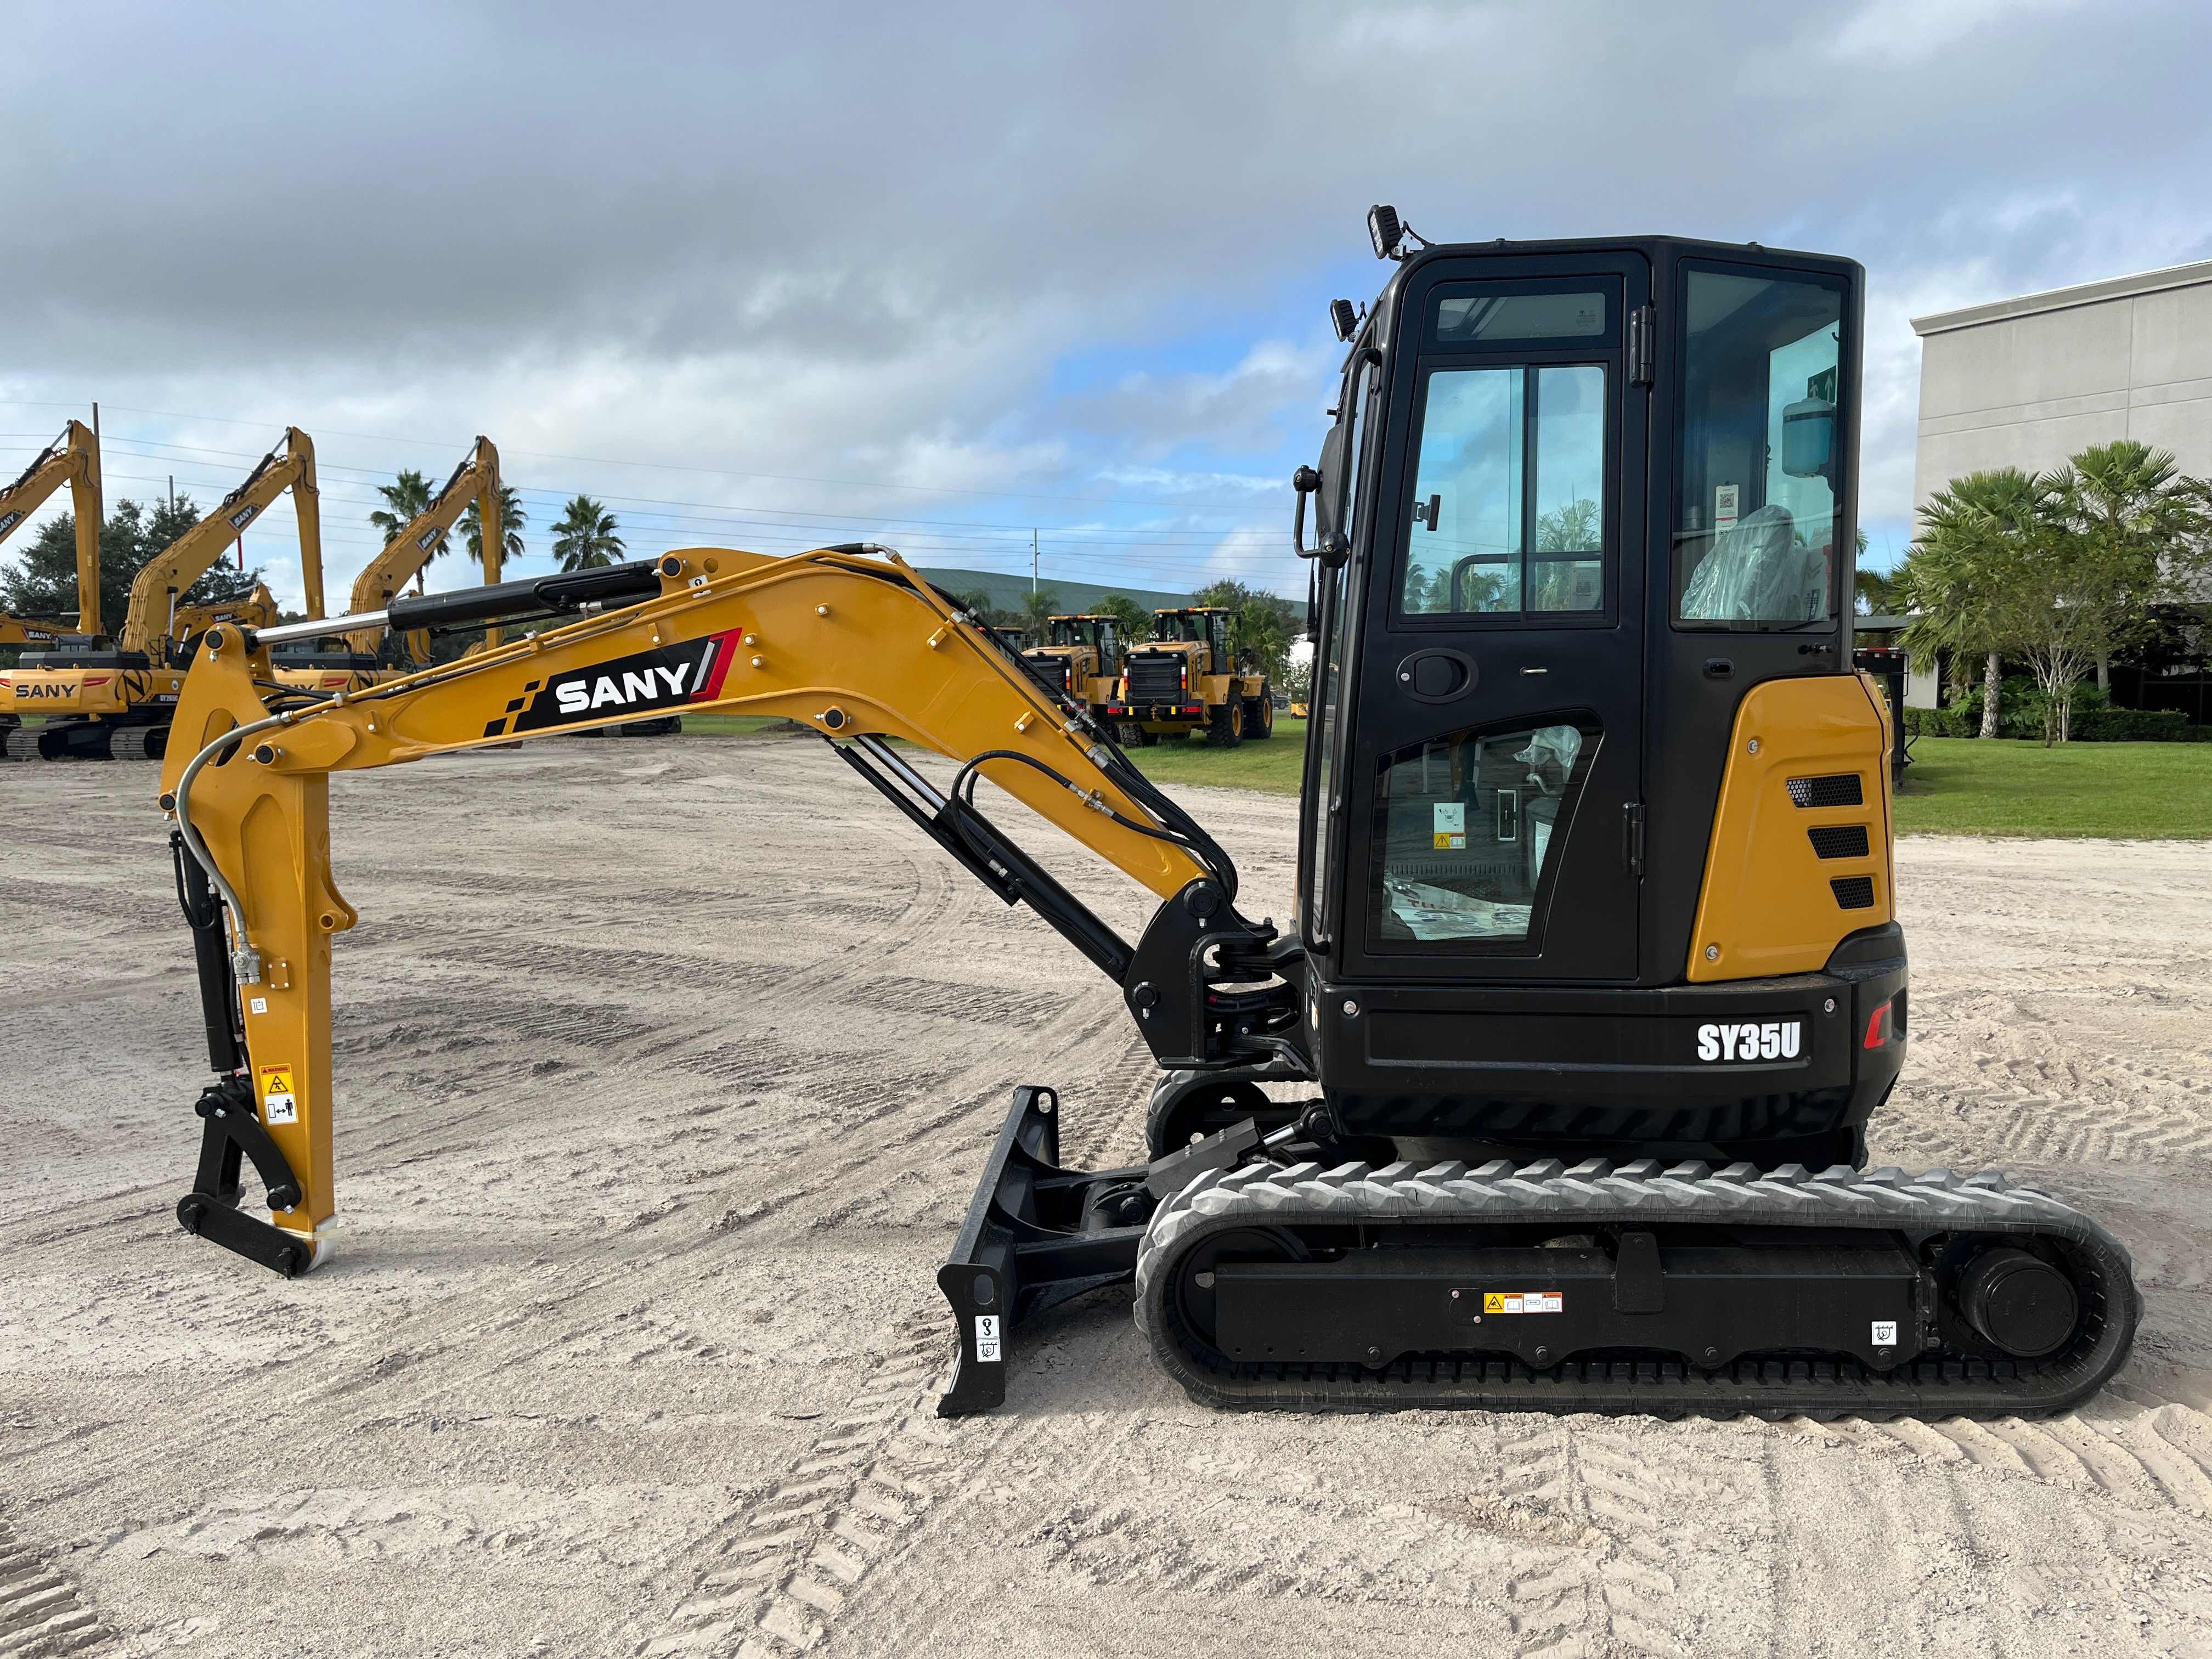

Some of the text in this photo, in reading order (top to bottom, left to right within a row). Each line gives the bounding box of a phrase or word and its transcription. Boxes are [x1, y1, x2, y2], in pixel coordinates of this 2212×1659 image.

[0, 512, 15, 532] ANY
[234, 506, 252, 527] SANY
[421, 528, 437, 548] SANY
[16, 685, 77, 698] SANY
[556, 663, 690, 714] SANY
[1697, 1022, 1801, 1061] SY35U
